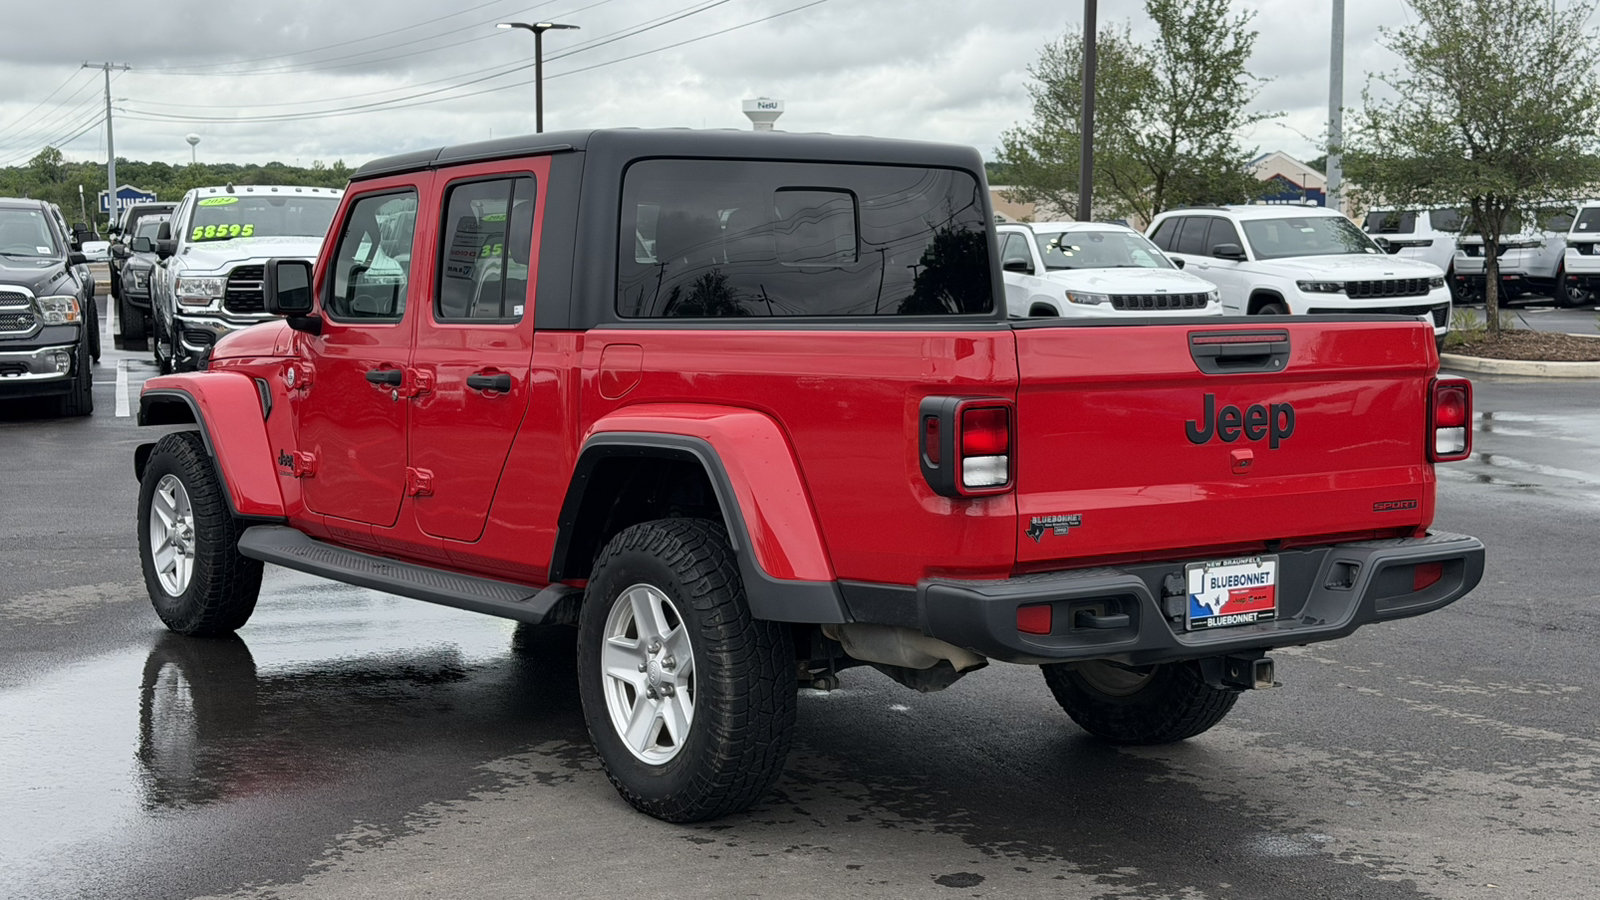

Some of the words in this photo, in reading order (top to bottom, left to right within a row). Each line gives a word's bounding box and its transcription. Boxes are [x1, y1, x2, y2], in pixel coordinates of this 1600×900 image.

[192, 224, 254, 241] 58595
[1185, 393, 1296, 450] Jeep
[278, 449, 294, 470] Jeep
[1374, 501, 1417, 511] SPORT
[1031, 514, 1082, 524] BLUEBONNET
[1211, 572, 1270, 589] BLUEBONNET
[1207, 613, 1258, 627] BLUEBONNET
